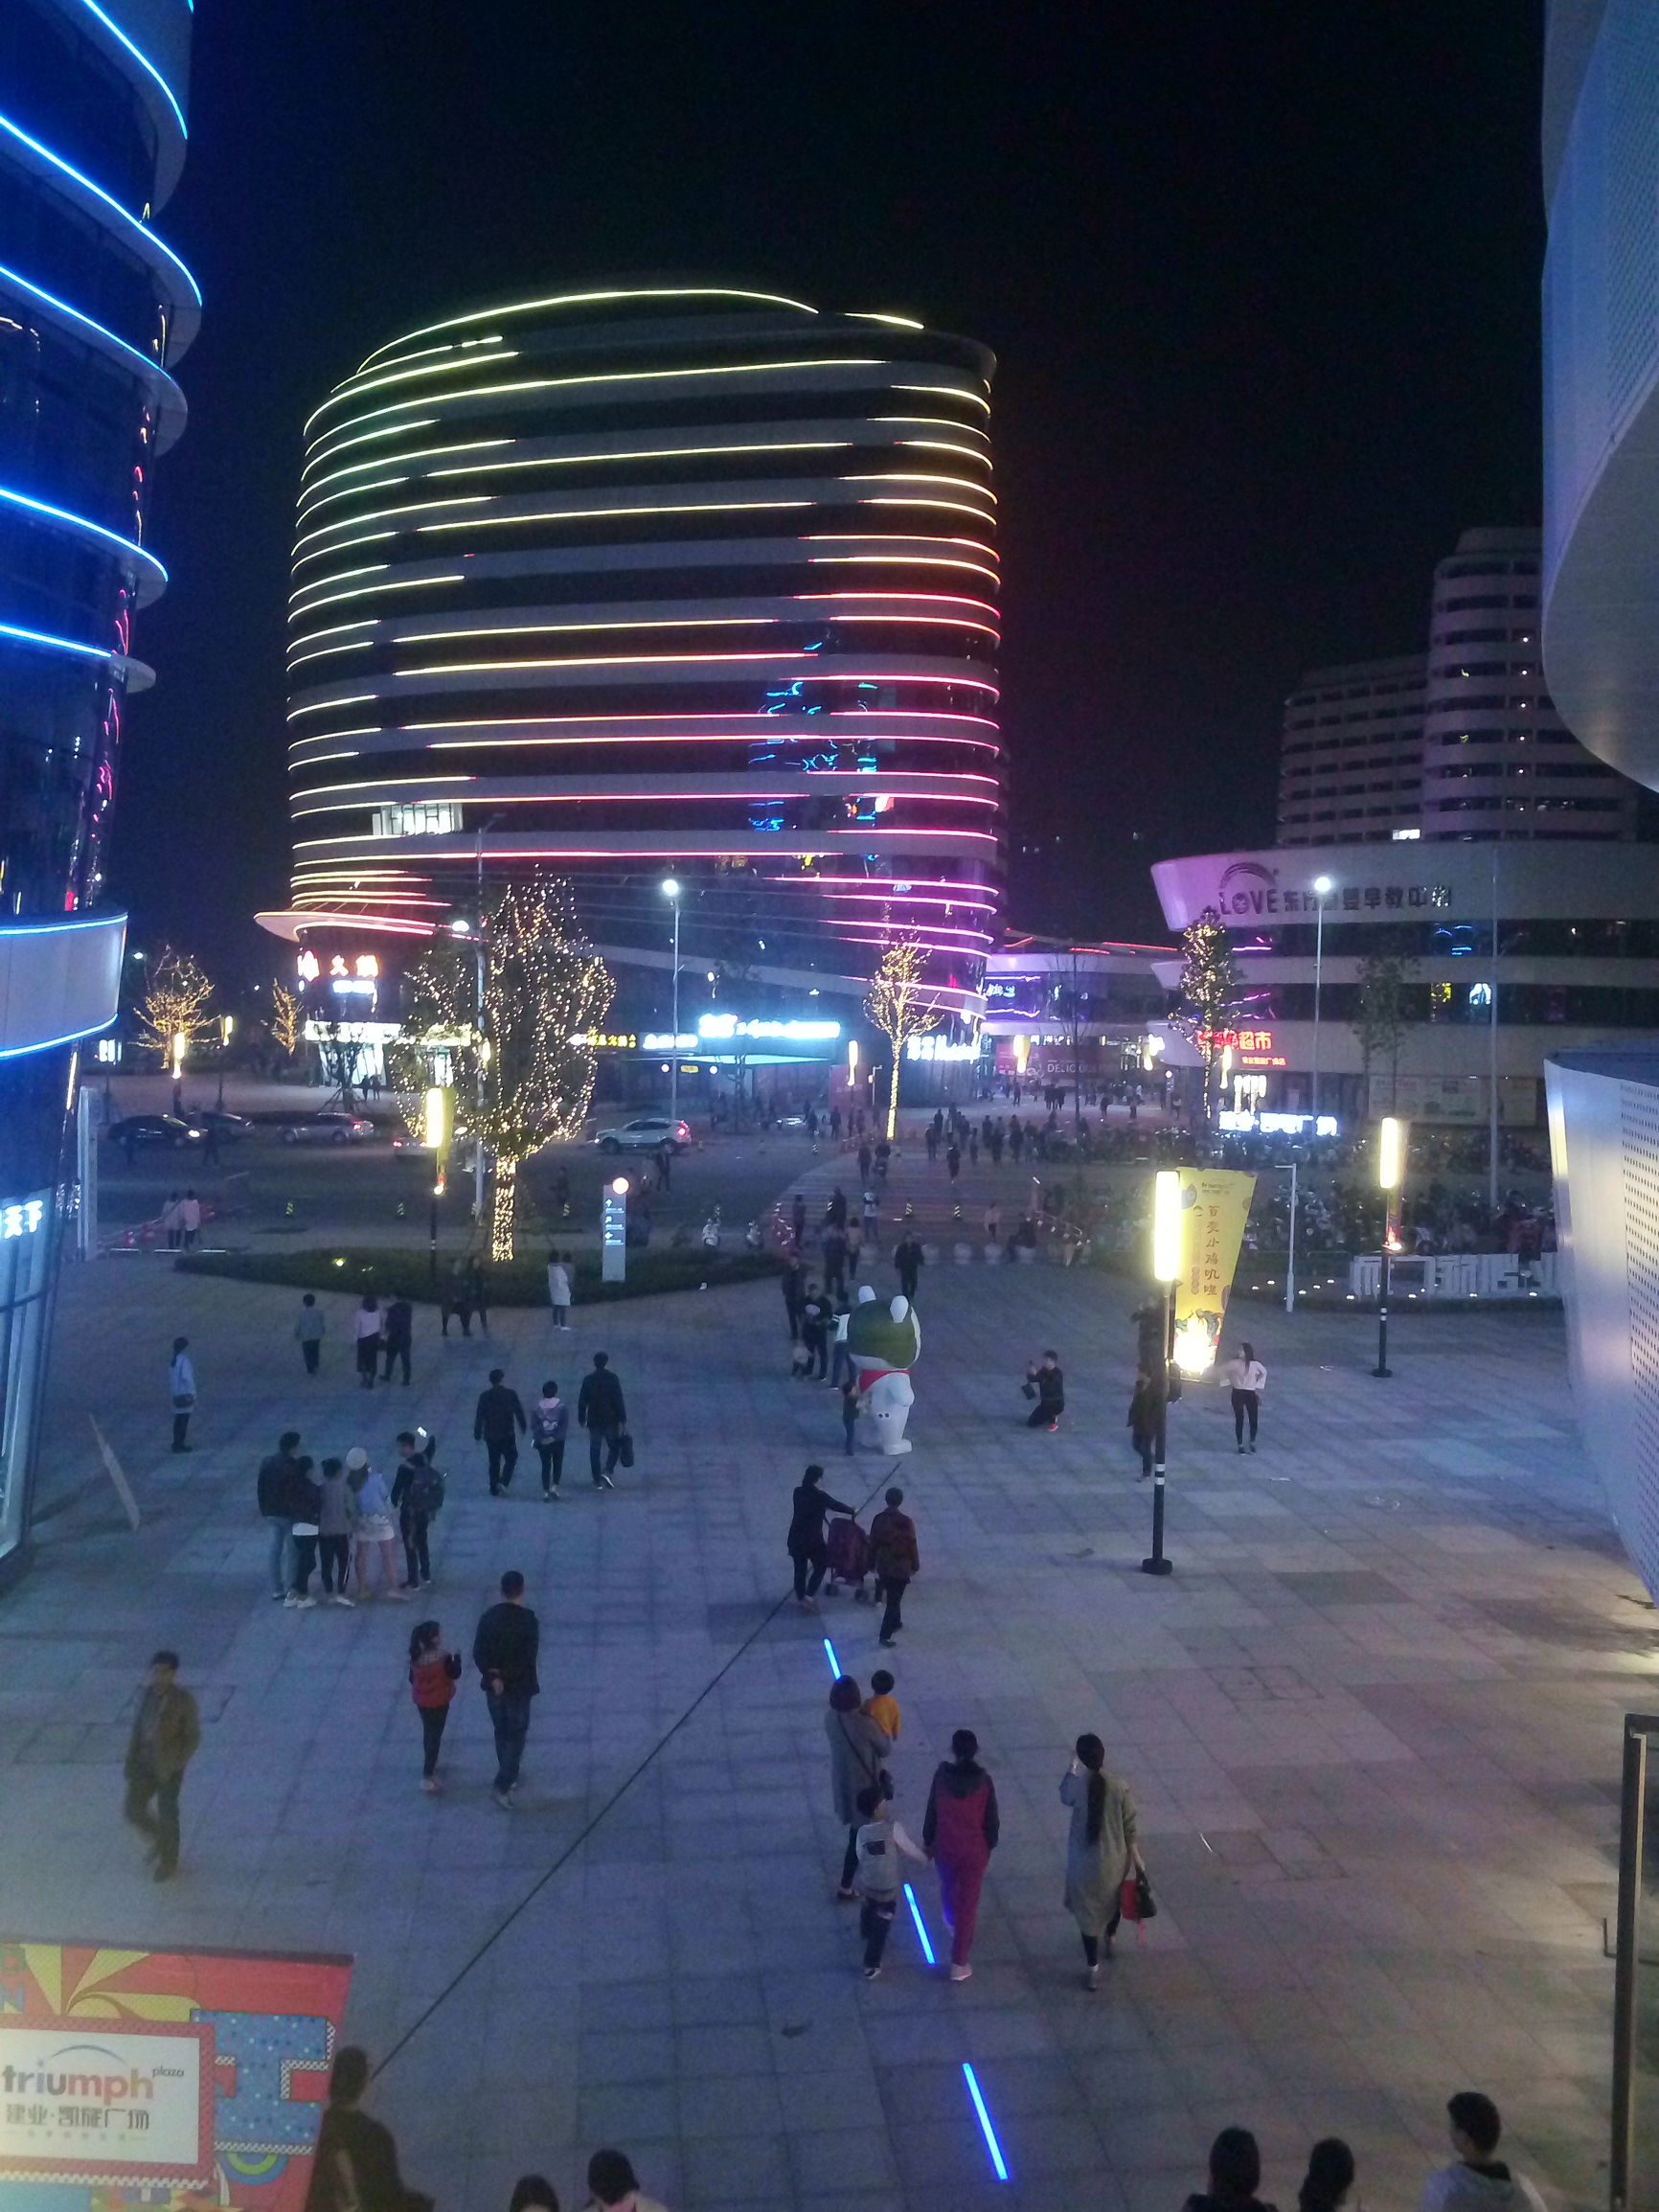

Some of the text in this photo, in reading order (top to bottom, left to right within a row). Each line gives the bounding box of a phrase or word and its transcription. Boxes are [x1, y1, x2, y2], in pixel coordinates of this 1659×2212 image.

[1218, 889, 1278, 915] LOVE
[3, 2059, 185, 2106] triumph plaza
